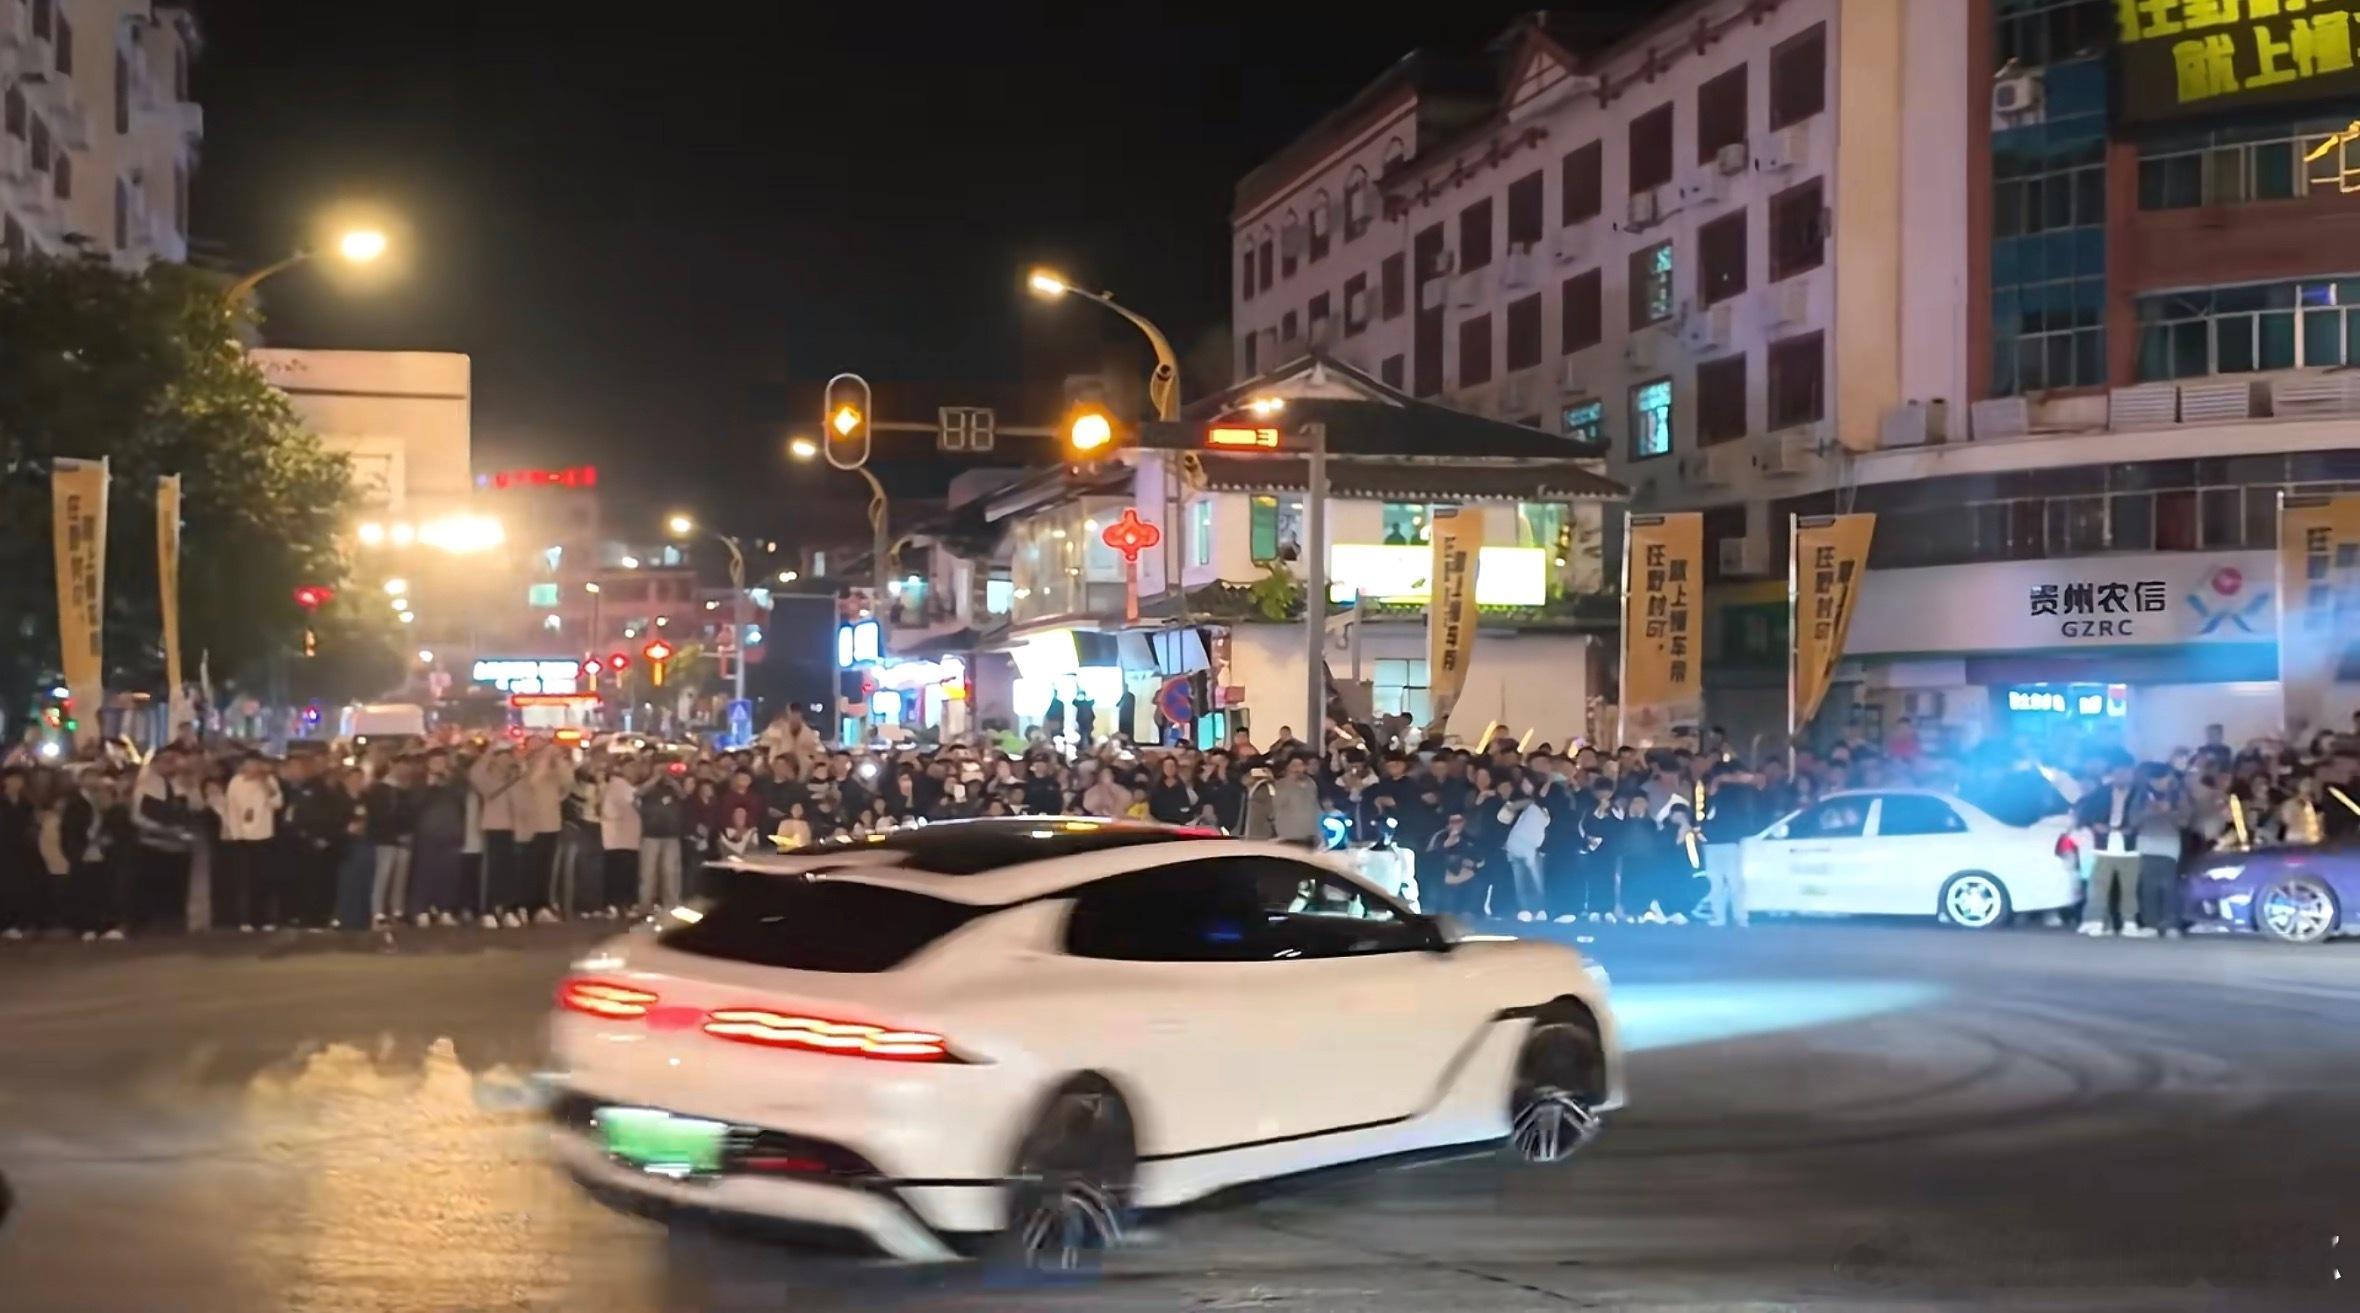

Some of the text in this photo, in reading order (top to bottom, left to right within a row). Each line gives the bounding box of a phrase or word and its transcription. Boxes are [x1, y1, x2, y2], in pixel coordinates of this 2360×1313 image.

[2030, 581, 2166, 616] 贵州农信
[2061, 619, 2133, 637] GZRC
